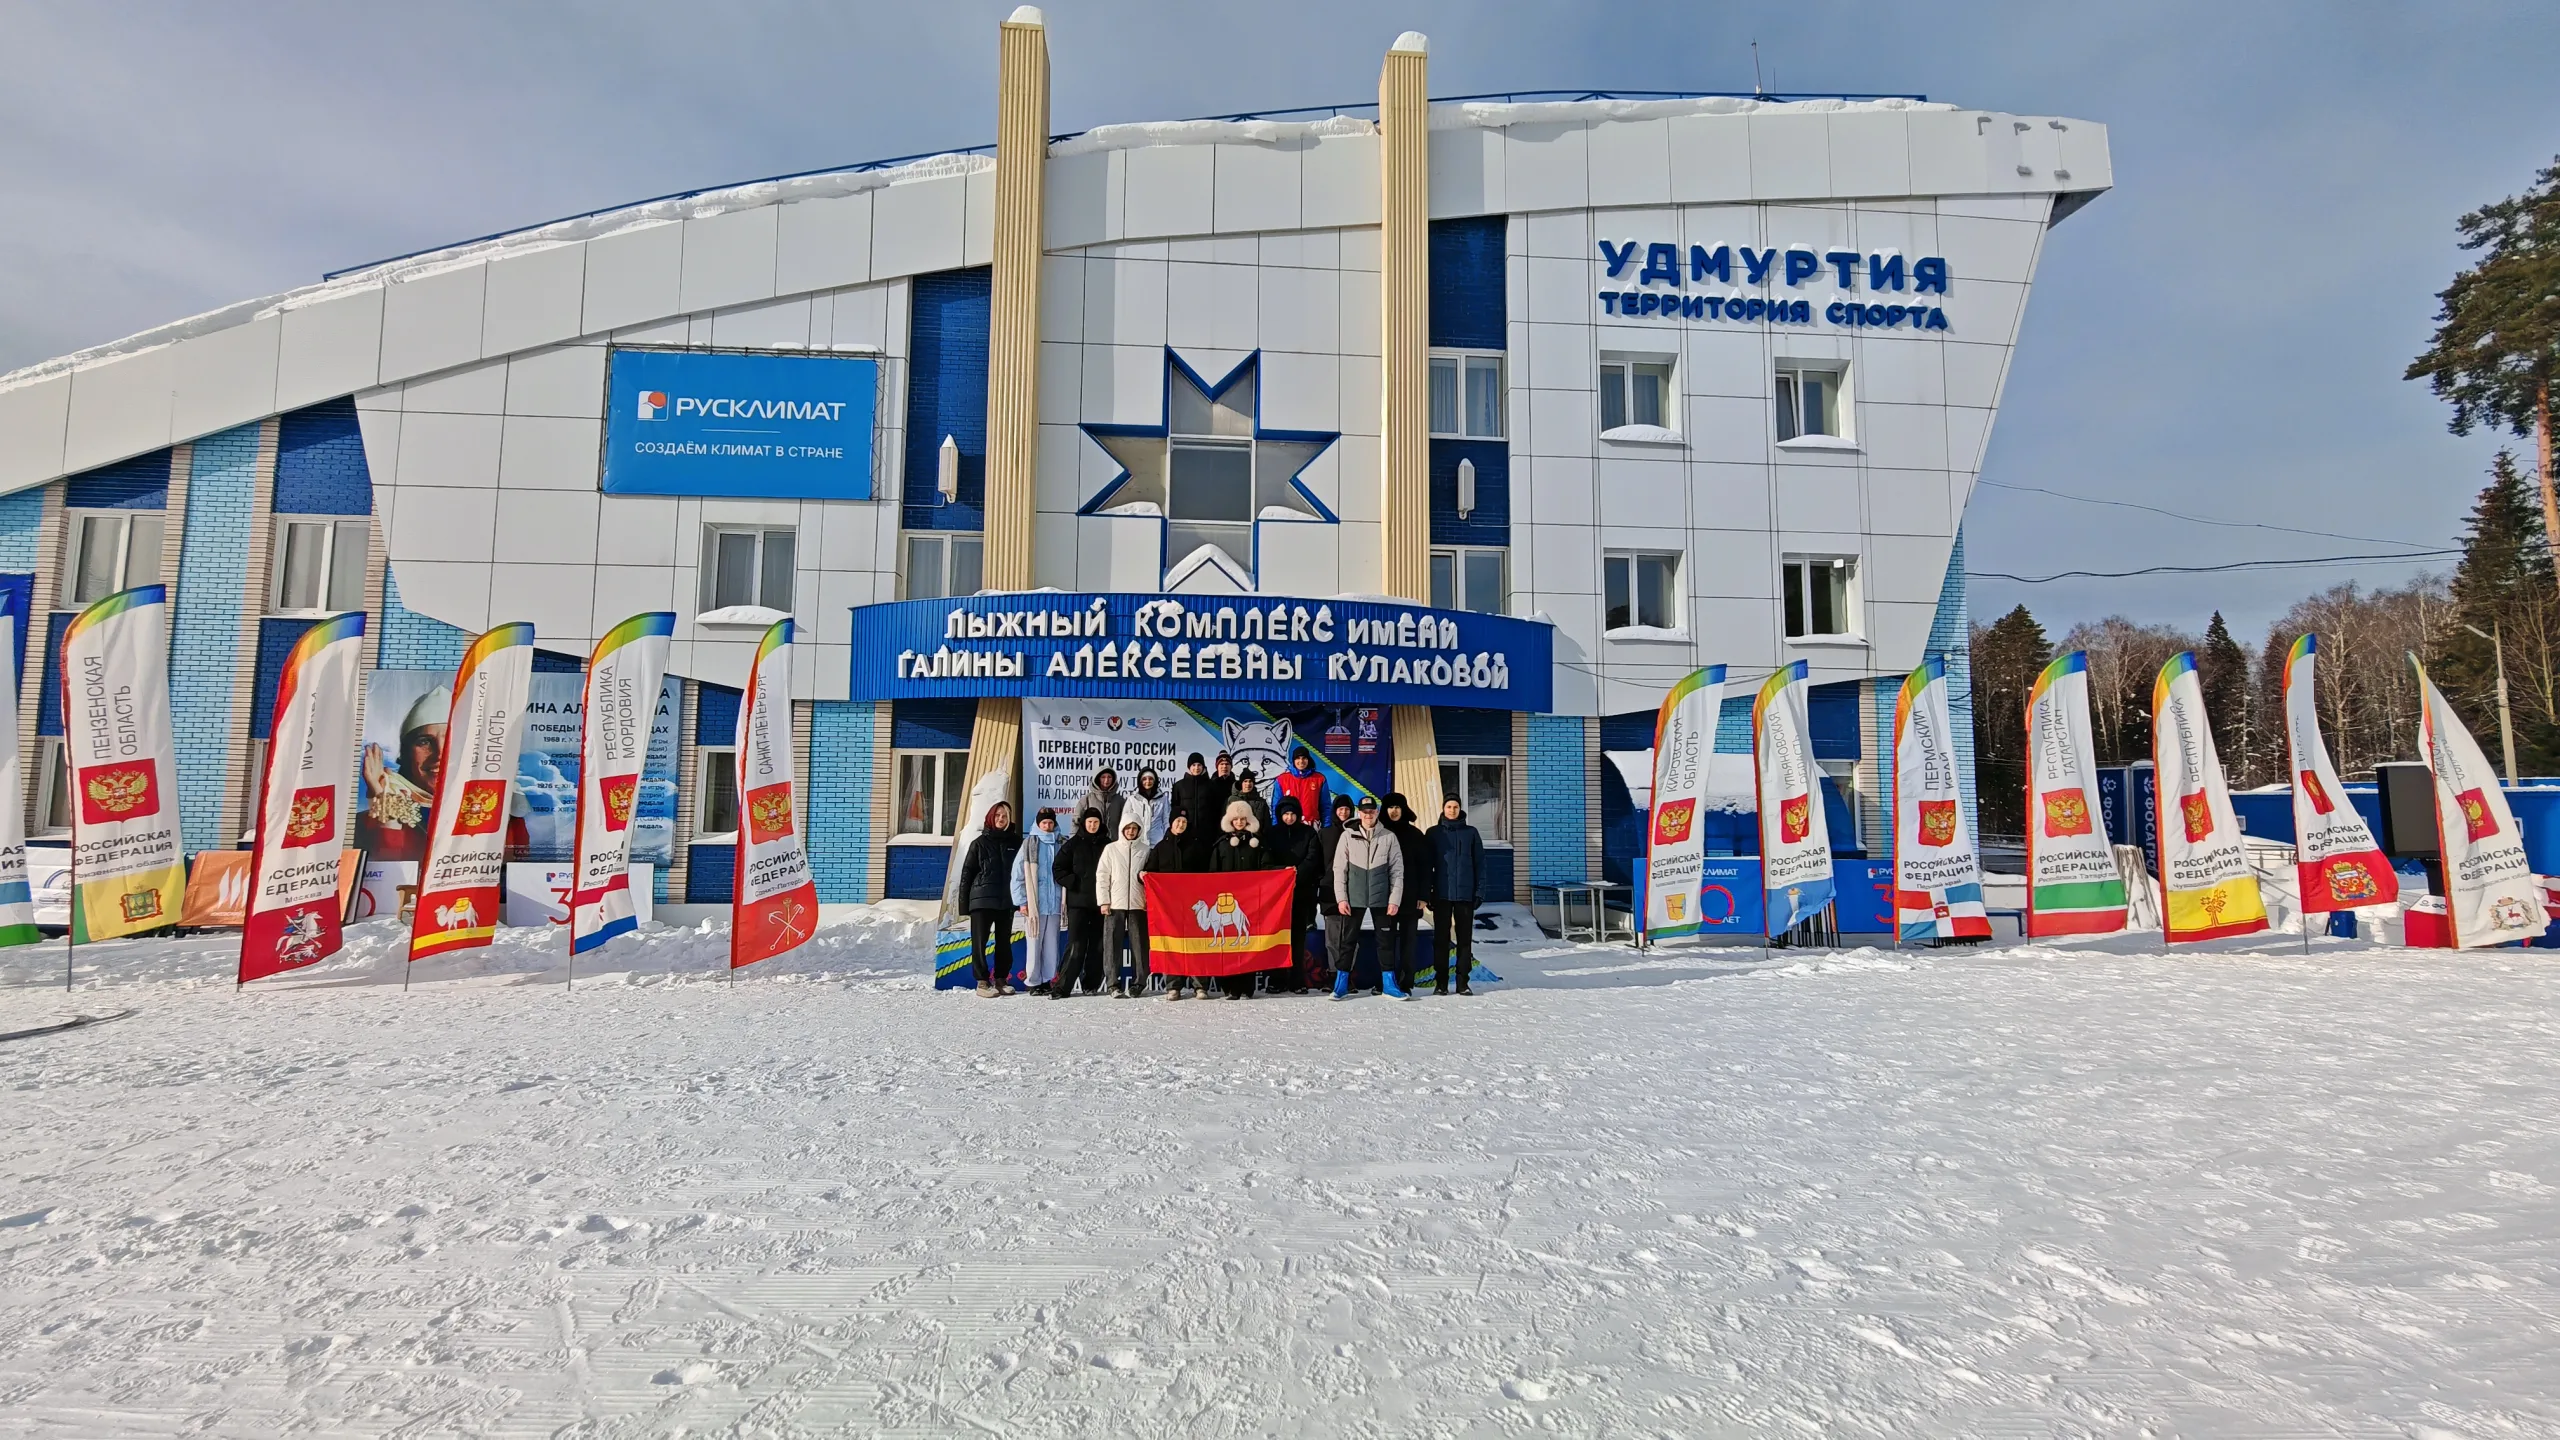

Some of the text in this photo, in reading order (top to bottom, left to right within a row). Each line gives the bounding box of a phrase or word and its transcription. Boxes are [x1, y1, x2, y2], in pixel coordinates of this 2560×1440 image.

[1599, 240, 1947, 293] УДМУРТИЯ
[1599, 291, 1949, 330] ТЕРРИТОРИЯ СПОРТА
[676, 398, 846, 421] РУСКЛИМАТ
[635, 441, 844, 459] СОЗДАЁМ КЛИМАТ В СТРАНЕ
[943, 603, 1458, 650] ЛЫЖНЫЙ КОМПЛЕКС ИМЕНИ
[897, 643, 1509, 690] ГАЛИНЫ АЛЕКСЕЕВНЫ КУЛАКОВОЙ
[84, 656, 112, 759] ПЕНЗЕНСКАЯ
[113, 685, 138, 756] ОБЛАСТЬ
[530, 724, 576, 733] ПОБЕДЫ
[600, 665, 618, 760] РЕСПУБЛИКА
[619, 678, 636, 759] МОРДОВИЯ
[755, 673, 774, 775] САНКТ-ПЕТЕРБУРГ
[485, 710, 505, 773] ОБЛАСТЬ
[1038, 739, 1176, 756] ПЕРВЕНСТВО РОССИИ
[1038, 755, 1093, 771] ЗИМНИЙ
[1147, 758, 1176, 772] ПФО
[1666, 716, 1683, 792] КИРОВСКАЯ
[1683, 731, 1698, 790] ОБЛАСТЬ
[1768, 711, 1796, 790] УЛЬЯНОВСКАЯ
[2054, 709, 2077, 776] ТАТАРСТАН
[1037, 788, 1051, 799] НА
[1038, 774, 1052, 786] ПО
[75, 829, 171, 853] РОССИЙСКАЯ
[2145, 797, 2157, 871] ФОСАГРО
[76, 864, 133, 879] ензенская
[285, 891, 322, 903] Москва
[1722, 916, 1741, 924] ЛЕТ
